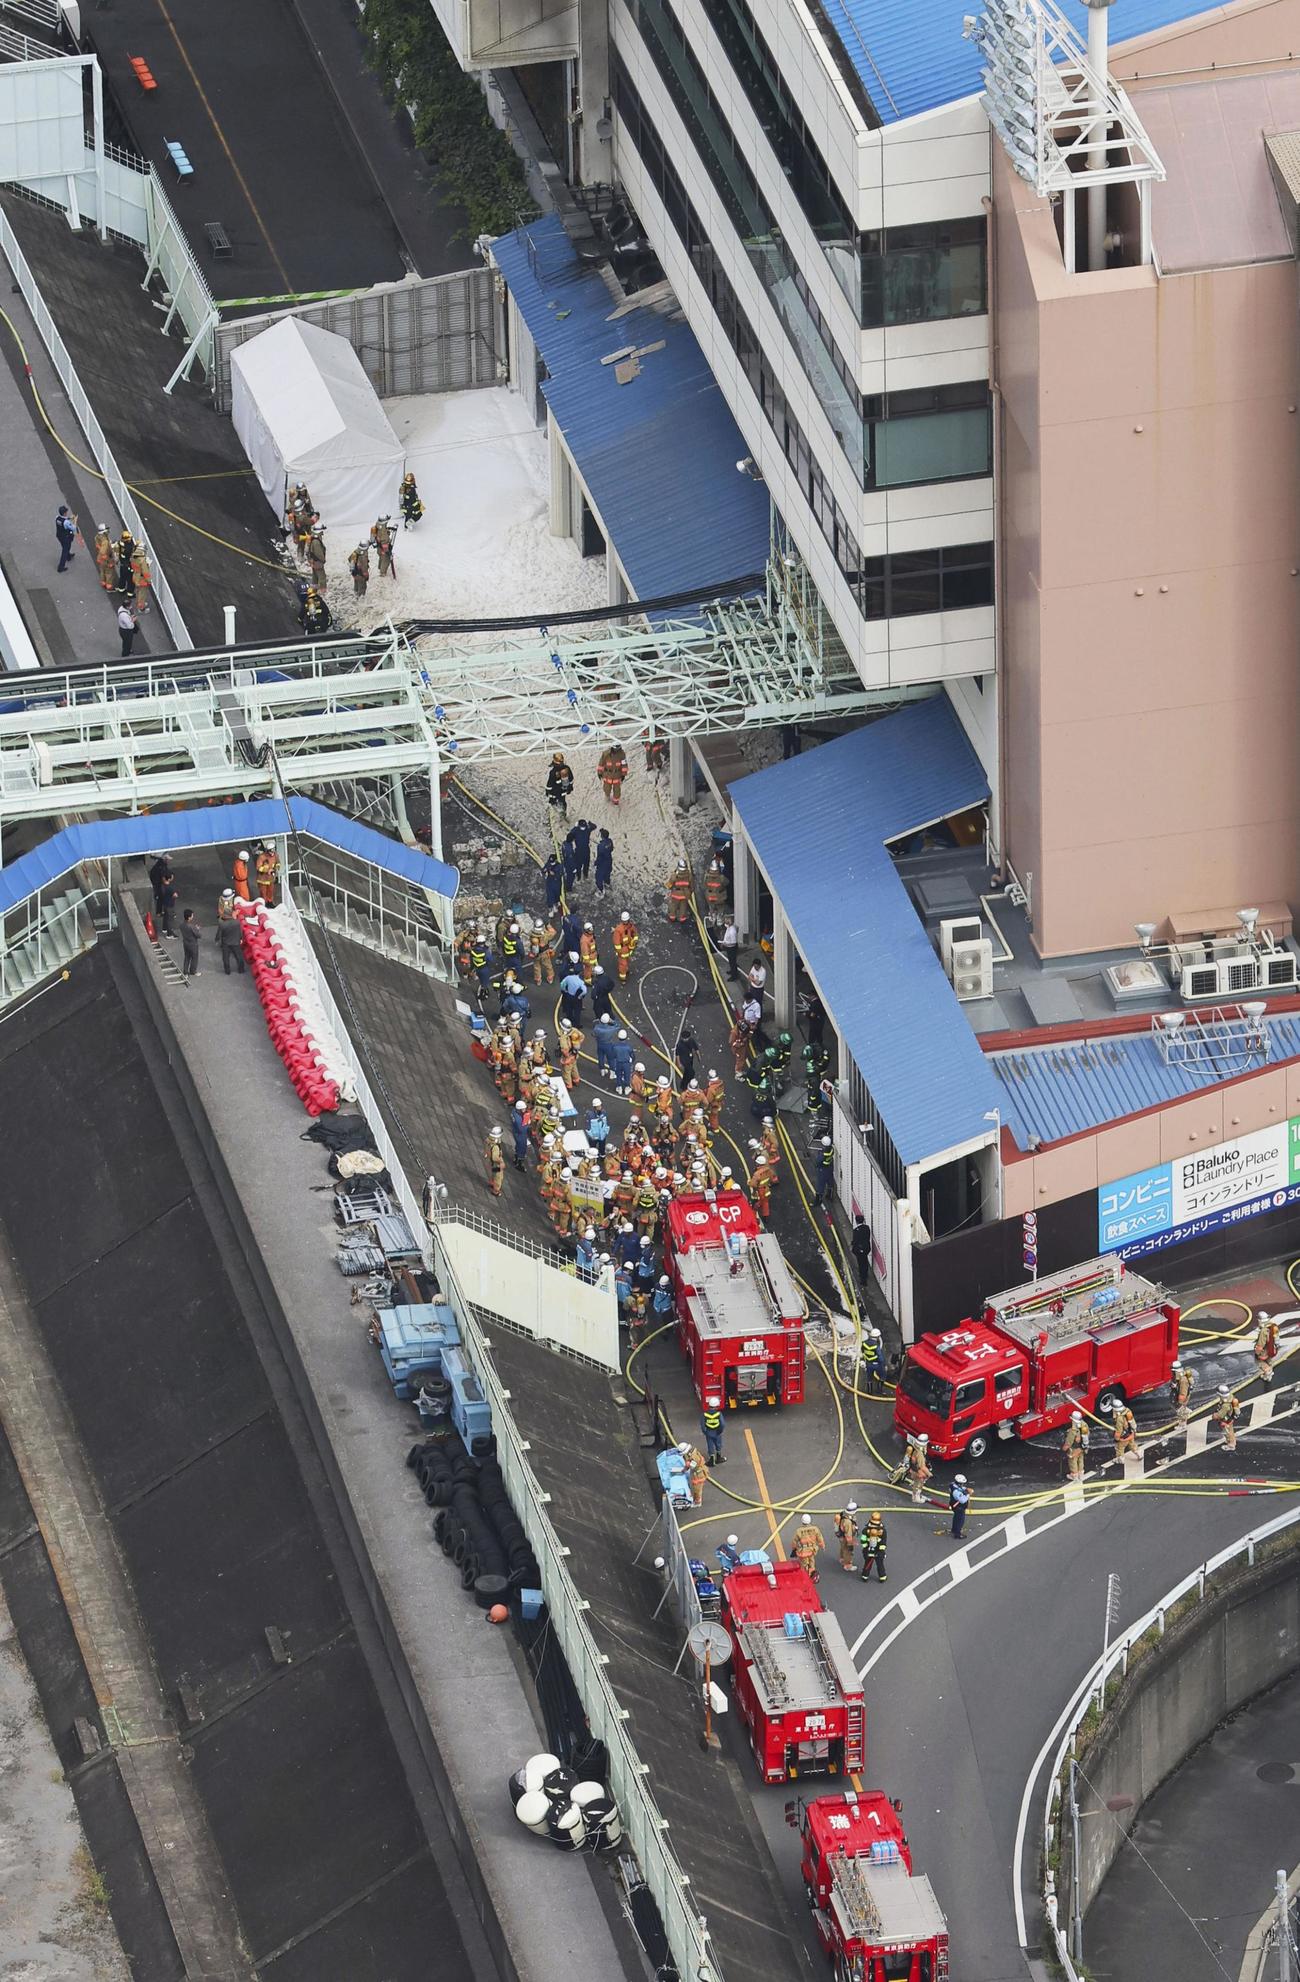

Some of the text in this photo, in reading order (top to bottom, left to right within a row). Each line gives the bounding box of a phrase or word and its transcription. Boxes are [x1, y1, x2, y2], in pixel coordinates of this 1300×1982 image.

[1196, 1150, 1240, 1172] Baluko
[1196, 1148, 1279, 1185] Laundry Place
[1102, 1176, 1170, 1216] コンビニ
[1187, 1173, 1275, 1211] コインランドリー
[719, 1205, 741, 1223] CP
[1107, 1207, 1166, 1240] 飲食スペース
[1222, 1197, 1271, 1223] ご利用者様
[868, 1811, 881, 1826] 1
